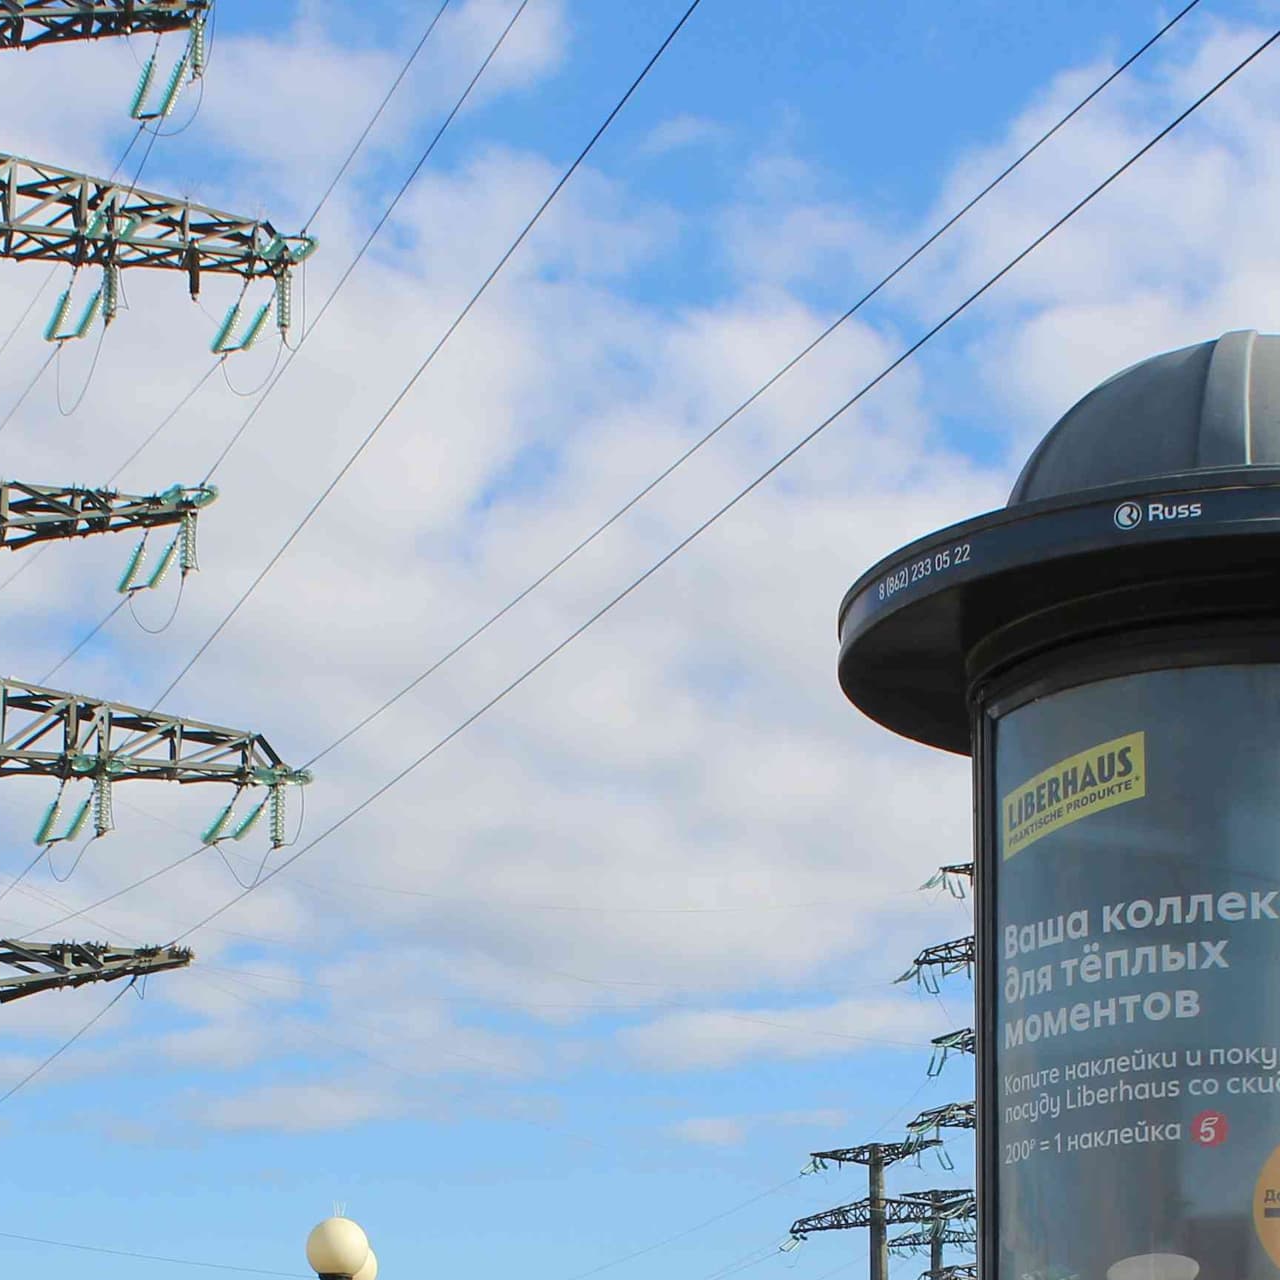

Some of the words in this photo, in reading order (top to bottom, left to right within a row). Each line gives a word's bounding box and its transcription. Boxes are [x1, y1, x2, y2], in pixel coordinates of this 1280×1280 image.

[879, 583, 885, 600] 8
[887, 567, 909, 597] (862)
[911, 558, 932, 582] 233
[935, 551, 950, 572] 05
[954, 544, 971, 565] 22
[1009, 746, 1134, 831] LIBERHAUS
[1009, 806, 1064, 848] PRAKTISCHE
[1005, 909, 1089, 959] Ваша
[1005, 965, 1052, 1003] для
[1061, 941, 1230, 986] тёплых
[1005, 990, 1201, 1049] моментов
[1005, 1068, 1060, 1096] Копите
[1065, 1049, 1177, 1081] наклейки
[1186, 1051, 1202, 1066] и
[1005, 1093, 1061, 1123] посуду
[1067, 1079, 1180, 1109] Liberhaus
[1188, 1078, 1219, 1096] со
[1054, 1132, 1062, 1153] 1
[1068, 1120, 1182, 1152] наклейка
